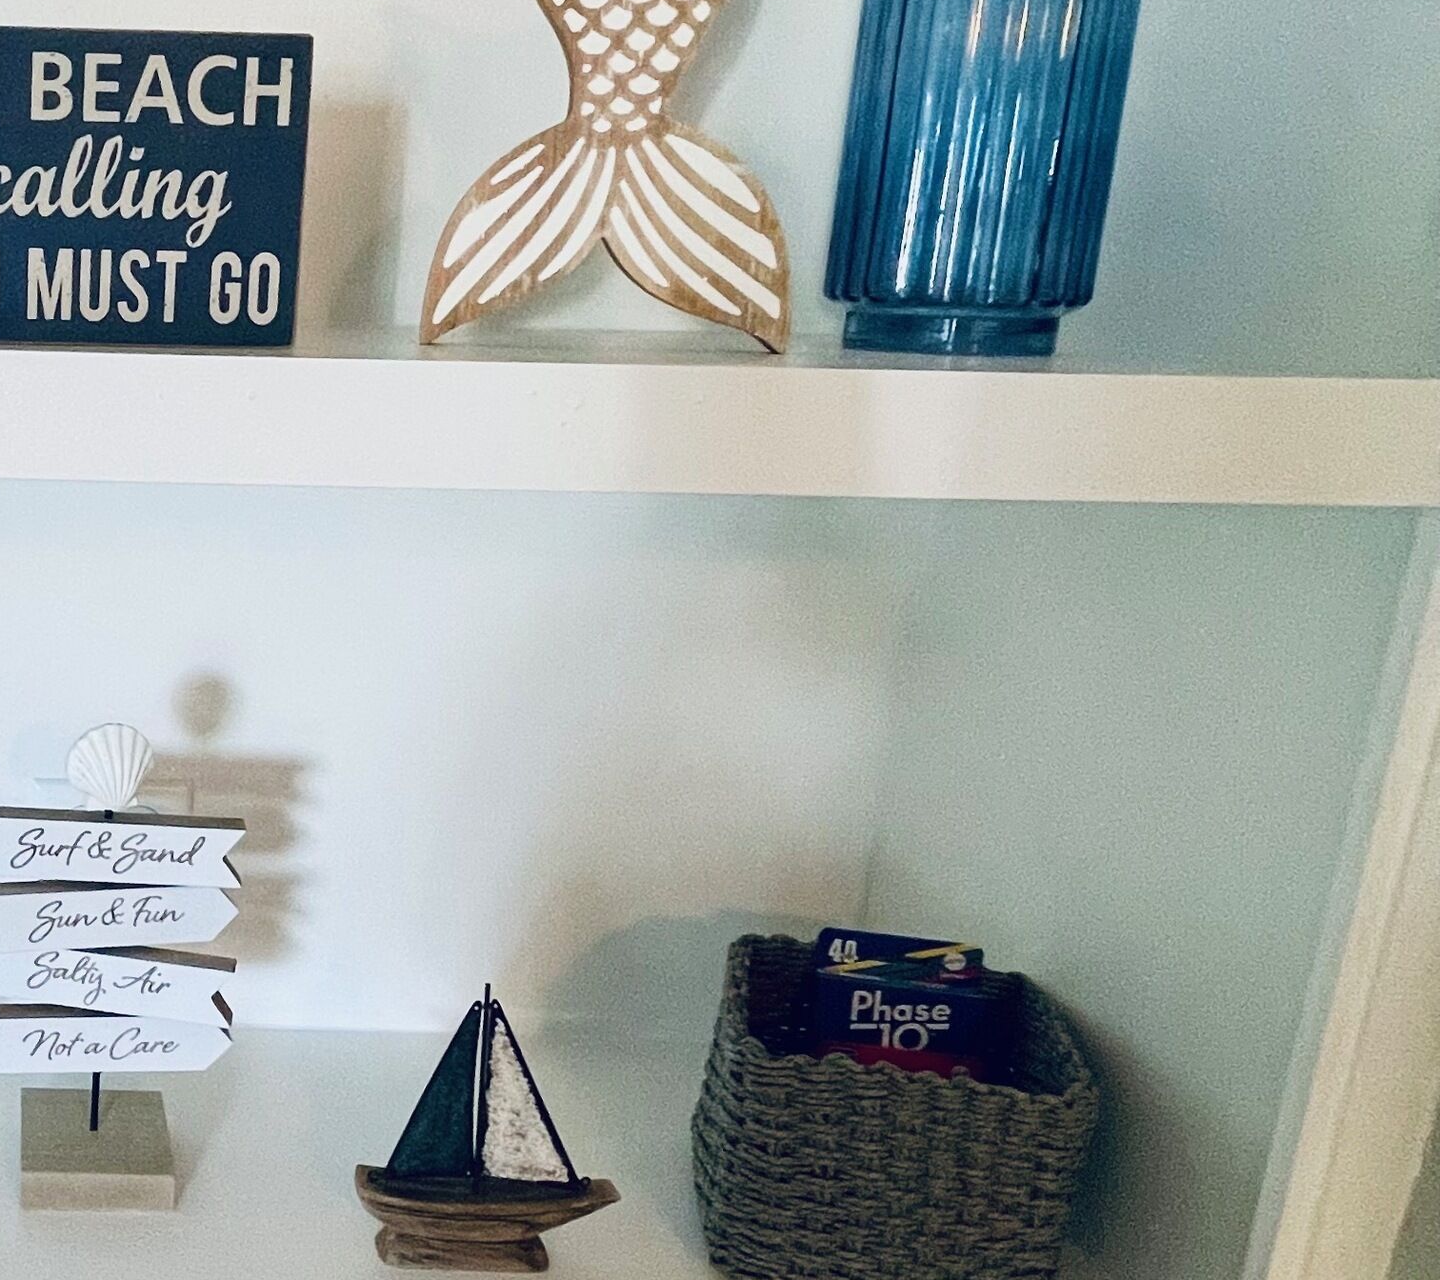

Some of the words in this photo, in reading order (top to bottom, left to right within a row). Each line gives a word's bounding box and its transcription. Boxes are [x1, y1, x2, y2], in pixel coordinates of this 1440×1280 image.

[30, 51, 293, 127] BEACH
[26, 247, 188, 324] MUST
[209, 251, 281, 325] GO
[10, 827, 91, 870] Surf
[87, 831, 111, 859] &
[112, 833, 206, 874] Sand
[28, 900, 97, 943] Sun
[101, 897, 125, 926] &
[131, 895, 185, 928] Fun
[26, 951, 107, 1005] Salty
[113, 966, 172, 995] Air
[849, 990, 951, 1021] Phase
[22, 1029, 83, 1060] Not
[84, 1041, 107, 1055] a
[110, 1027, 180, 1061] Care
[878, 1023, 930, 1051] 10
